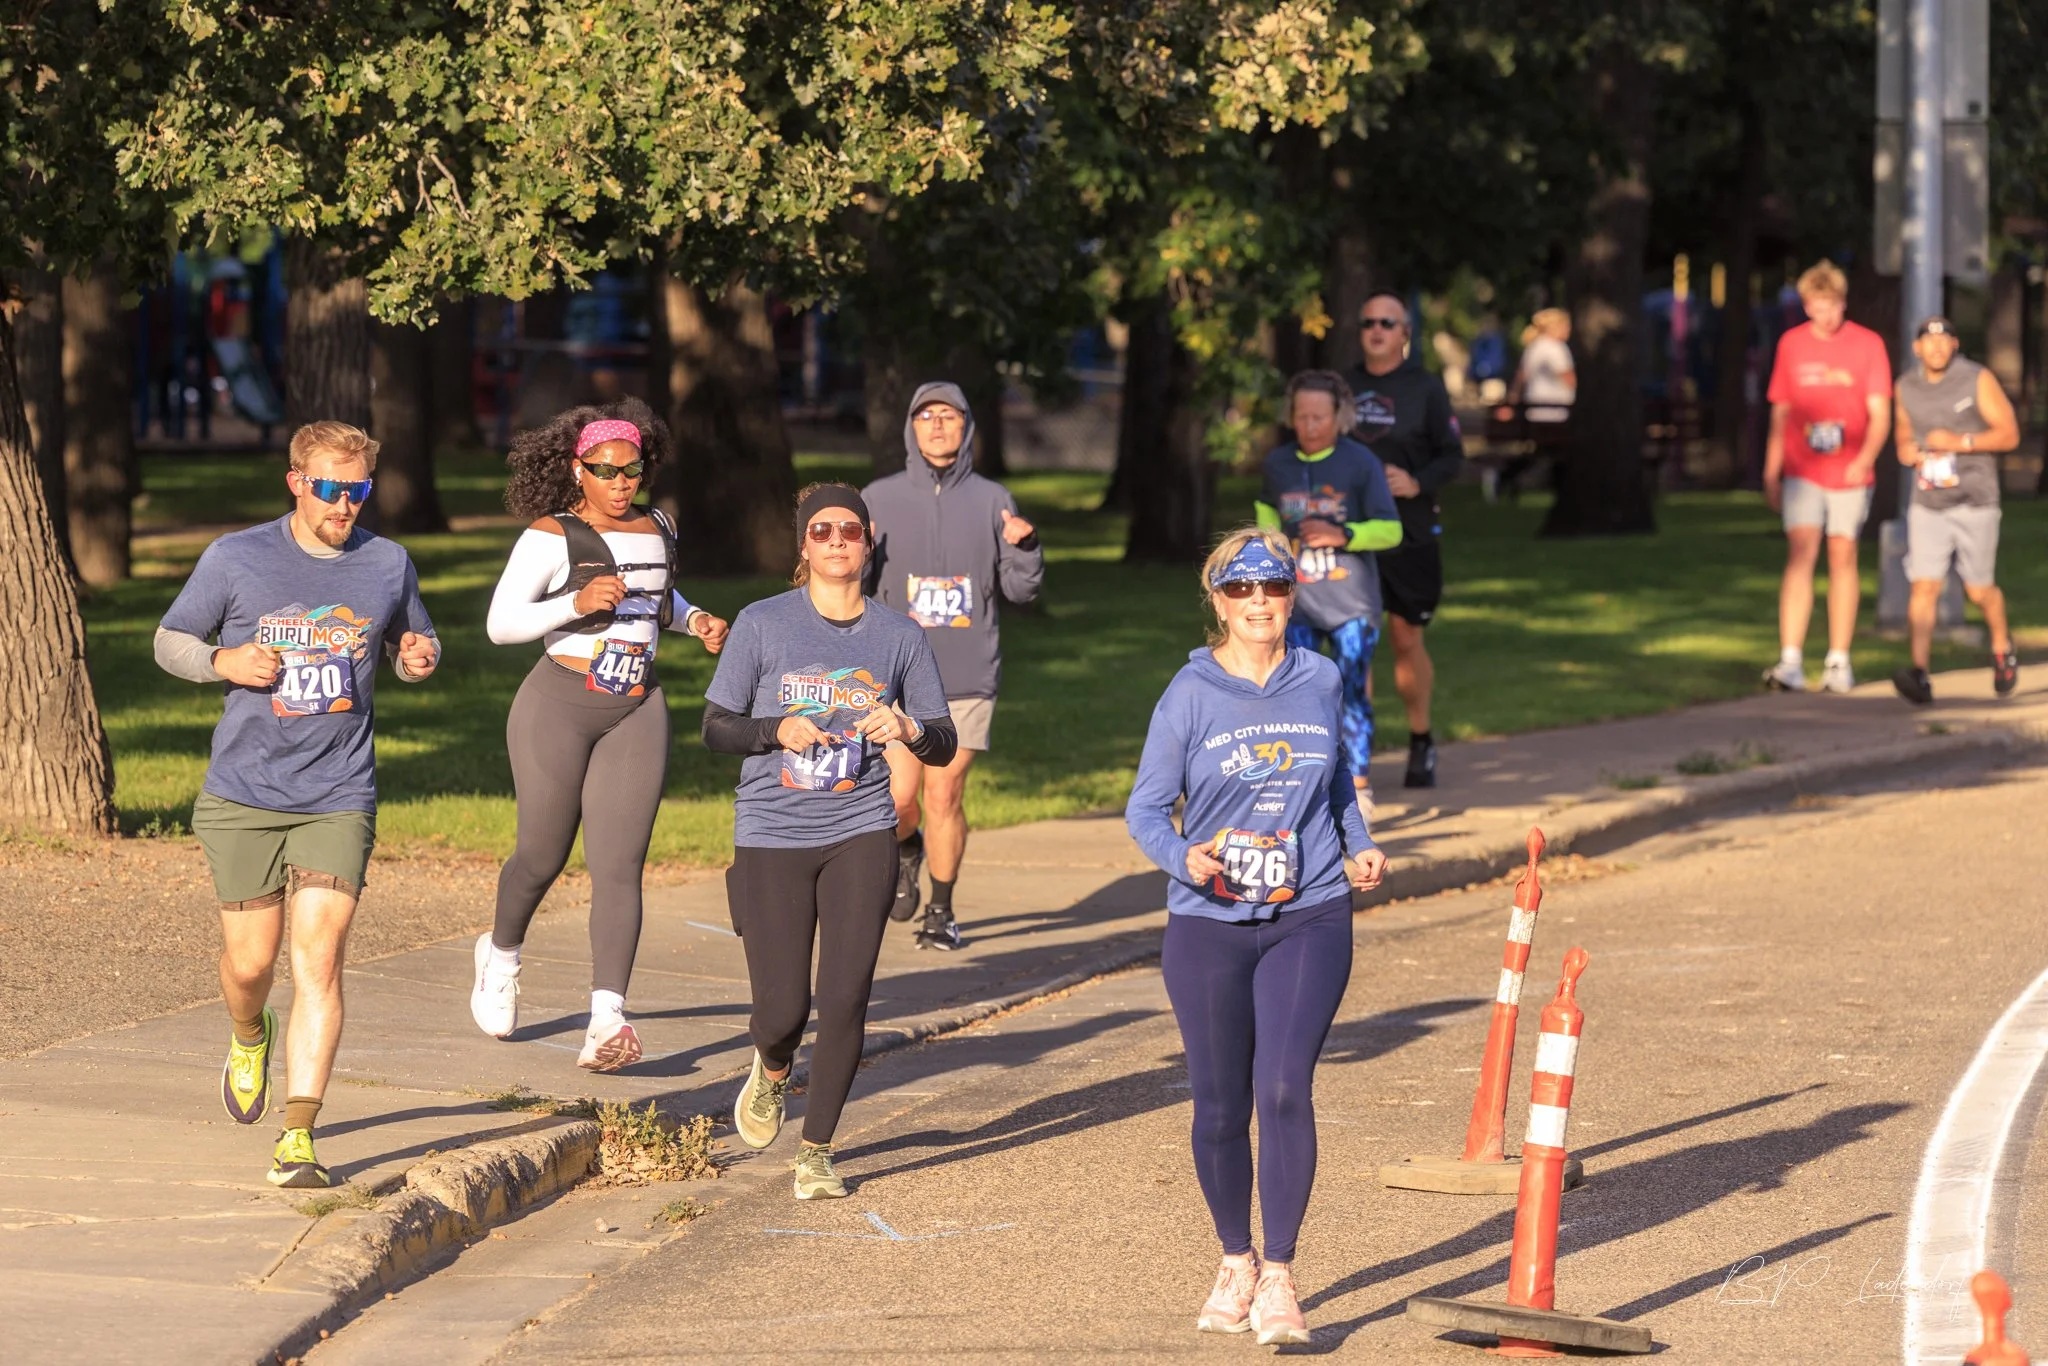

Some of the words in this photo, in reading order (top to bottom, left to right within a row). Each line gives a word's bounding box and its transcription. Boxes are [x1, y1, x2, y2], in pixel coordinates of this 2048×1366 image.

[916, 589, 962, 616] 442
[261, 618, 314, 626] SCHEELS
[281, 664, 341, 701] 420
[596, 652, 645, 685] 445
[782, 675, 836, 686] SCHEELS
[1205, 732, 1232, 750] MED
[1234, 724, 1262, 740] CITY
[1264, 723, 1329, 736] MARATHON
[795, 745, 849, 779] 421
[1253, 740, 1293, 771] 30
[1223, 846, 1287, 888] 426
